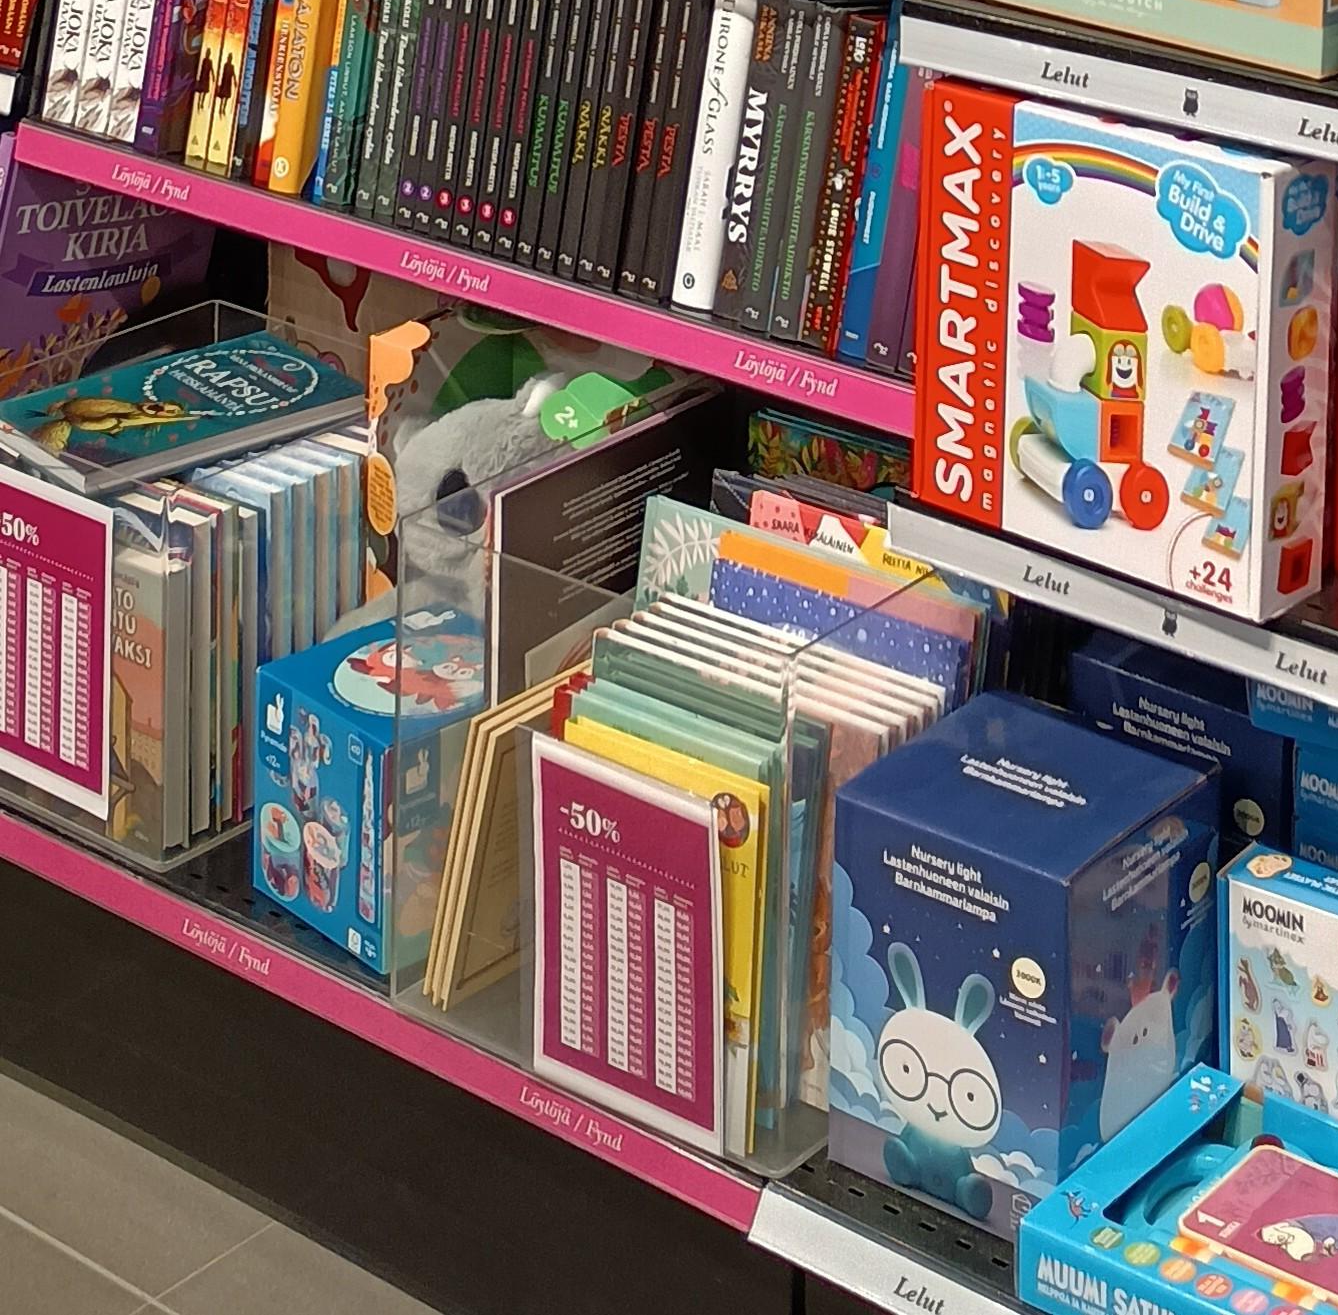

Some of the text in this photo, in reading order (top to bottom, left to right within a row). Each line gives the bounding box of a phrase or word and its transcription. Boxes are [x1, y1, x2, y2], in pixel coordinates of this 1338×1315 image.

[1041, 61, 1090, 90] Lelut
[701, 97, 722, 157] GLASS
[111, 163, 190, 203] Löytöjä Fynd
[728, 87, 768, 244] MYRRYS
[1172, 169, 1215, 201] My First
[1167, 185, 1226, 235] Build &
[1178, 212, 1226, 252] Drive
[62, 223, 149, 263] KIRJA
[41, 262, 159, 294] Lastenlauluja
[400, 246, 491, 295] Löytöjä Fynd
[935, 115, 983, 504] SMARTMAX
[981, 127, 1006, 513] magnetic discovery
[184, 359, 279, 406] RAPSU
[733, 349, 840, 399] Löytöjä Fynd
[1022, 565, 1071, 596] Lelut
[1188, 559, 1234, 593] +24
[1275, 651, 1329, 686] Lelut
[559, 801, 622, 845] -50%
[882, 848, 1011, 912] Lastenhuoneen valaisin
[910, 843, 983, 885] Nursery light
[1241, 896, 1305, 935] MOOMIN
[181, 916, 272, 977] Löytöjä Fynd
[518, 1083, 625, 1157] Löytöjä Fynd
[892, 1275, 946, 1314] Lelut
[1036, 1251, 1108, 1309] MUUMI
